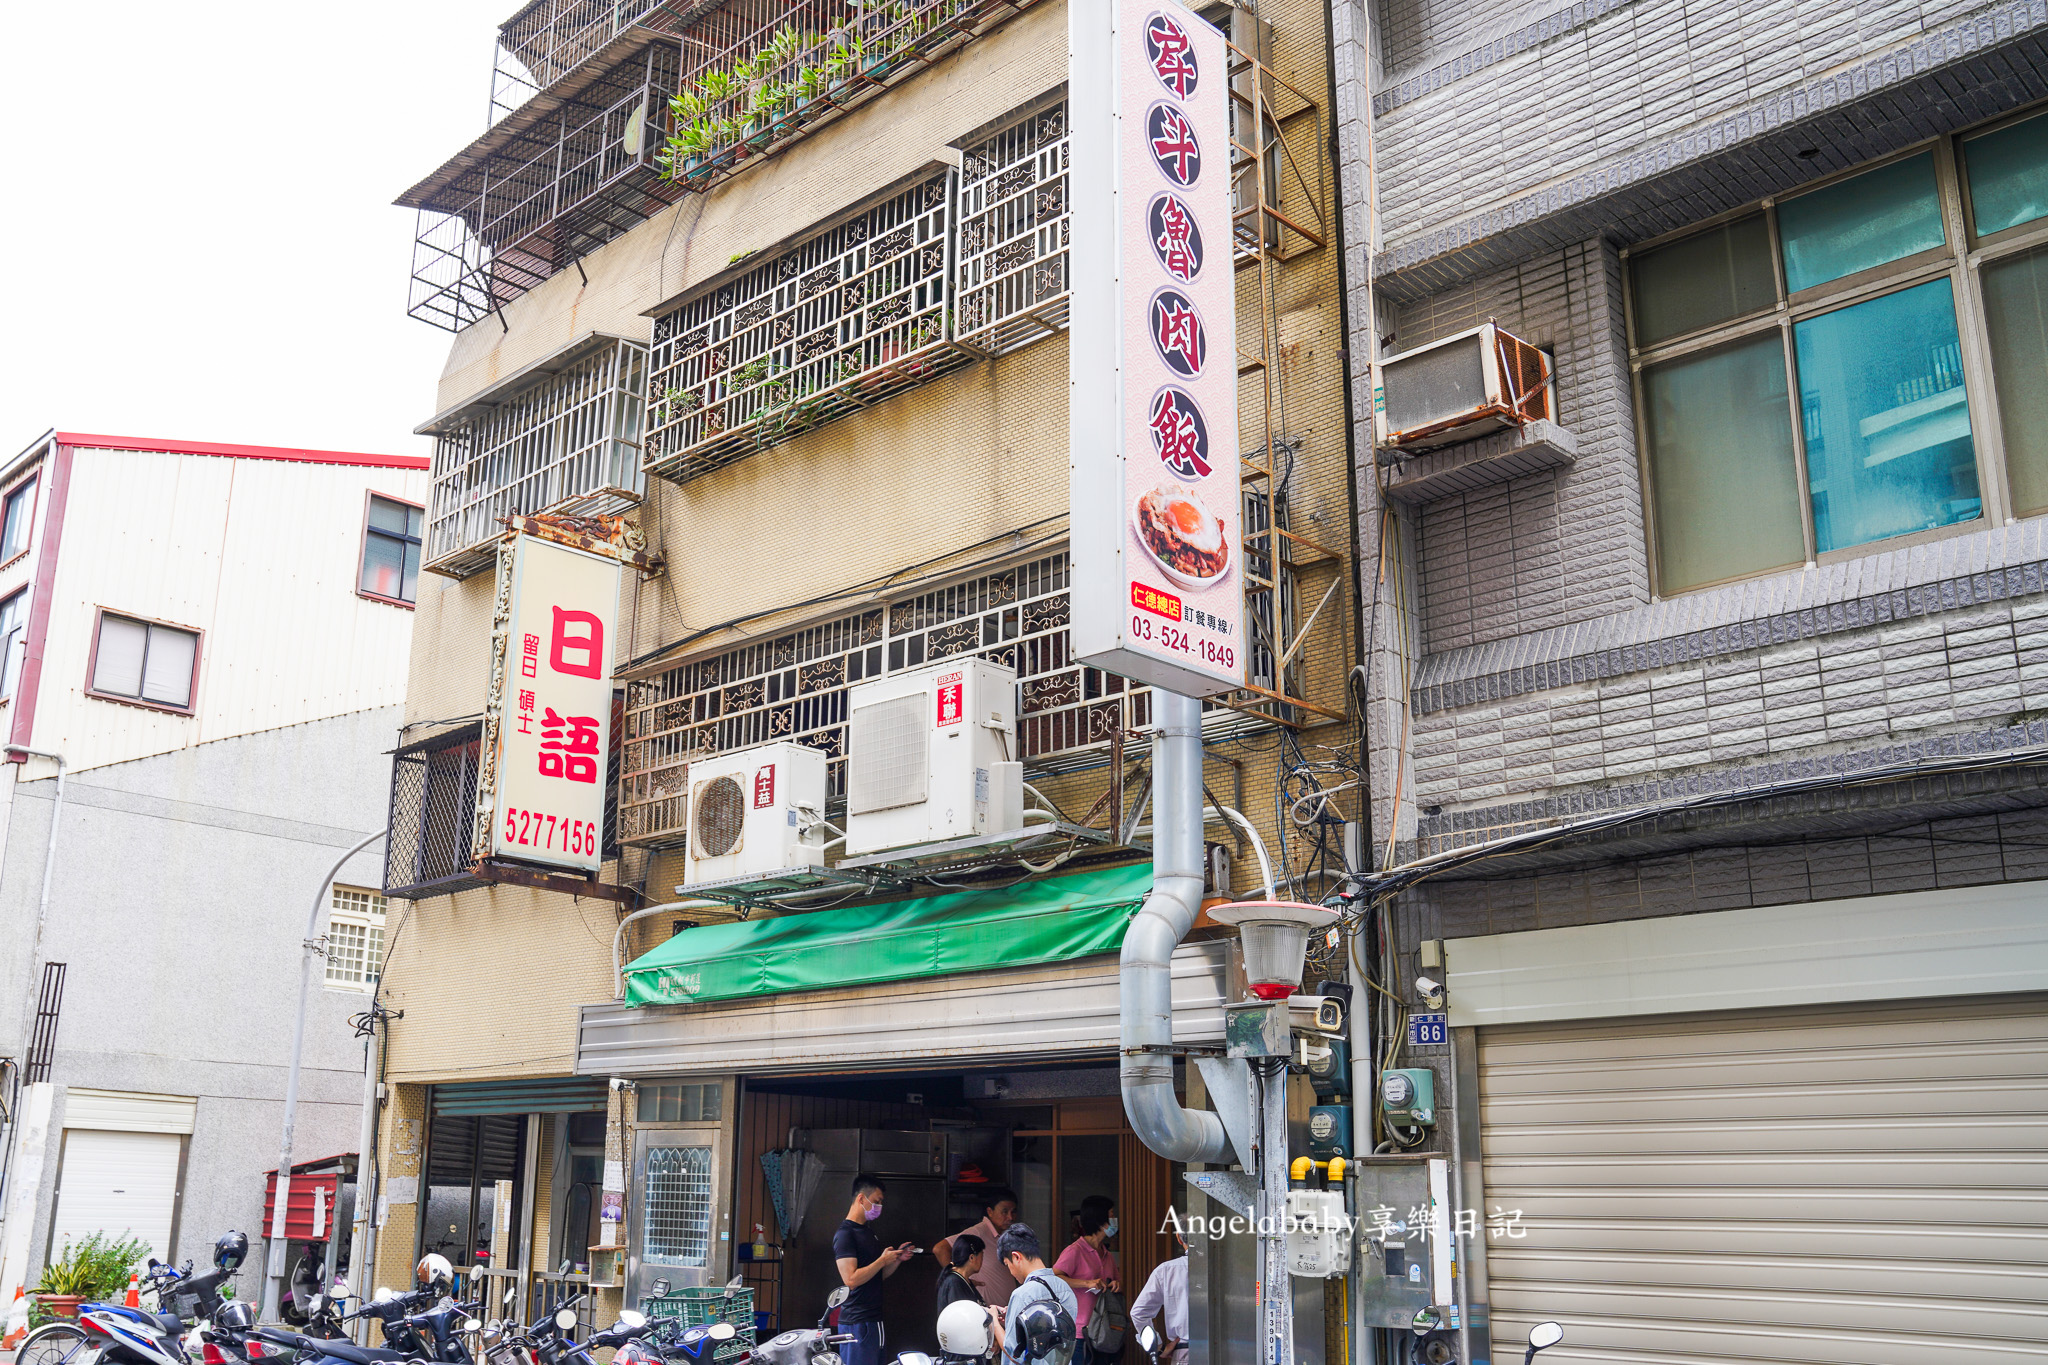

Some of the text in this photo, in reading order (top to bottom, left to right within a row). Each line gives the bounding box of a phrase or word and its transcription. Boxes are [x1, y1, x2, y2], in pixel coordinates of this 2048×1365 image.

[1133, 586, 1180, 618] 仁德總店
[1132, 615, 1234, 668] 03-524-1849
[517, 633, 540, 735] 留日 碩士
[538, 605, 604, 784] 日語
[938, 672, 962, 684] HERAN
[943, 685, 956, 720] 禾聯
[505, 807, 596, 857] 5277156
[1420, 1025, 1441, 1041] 86
